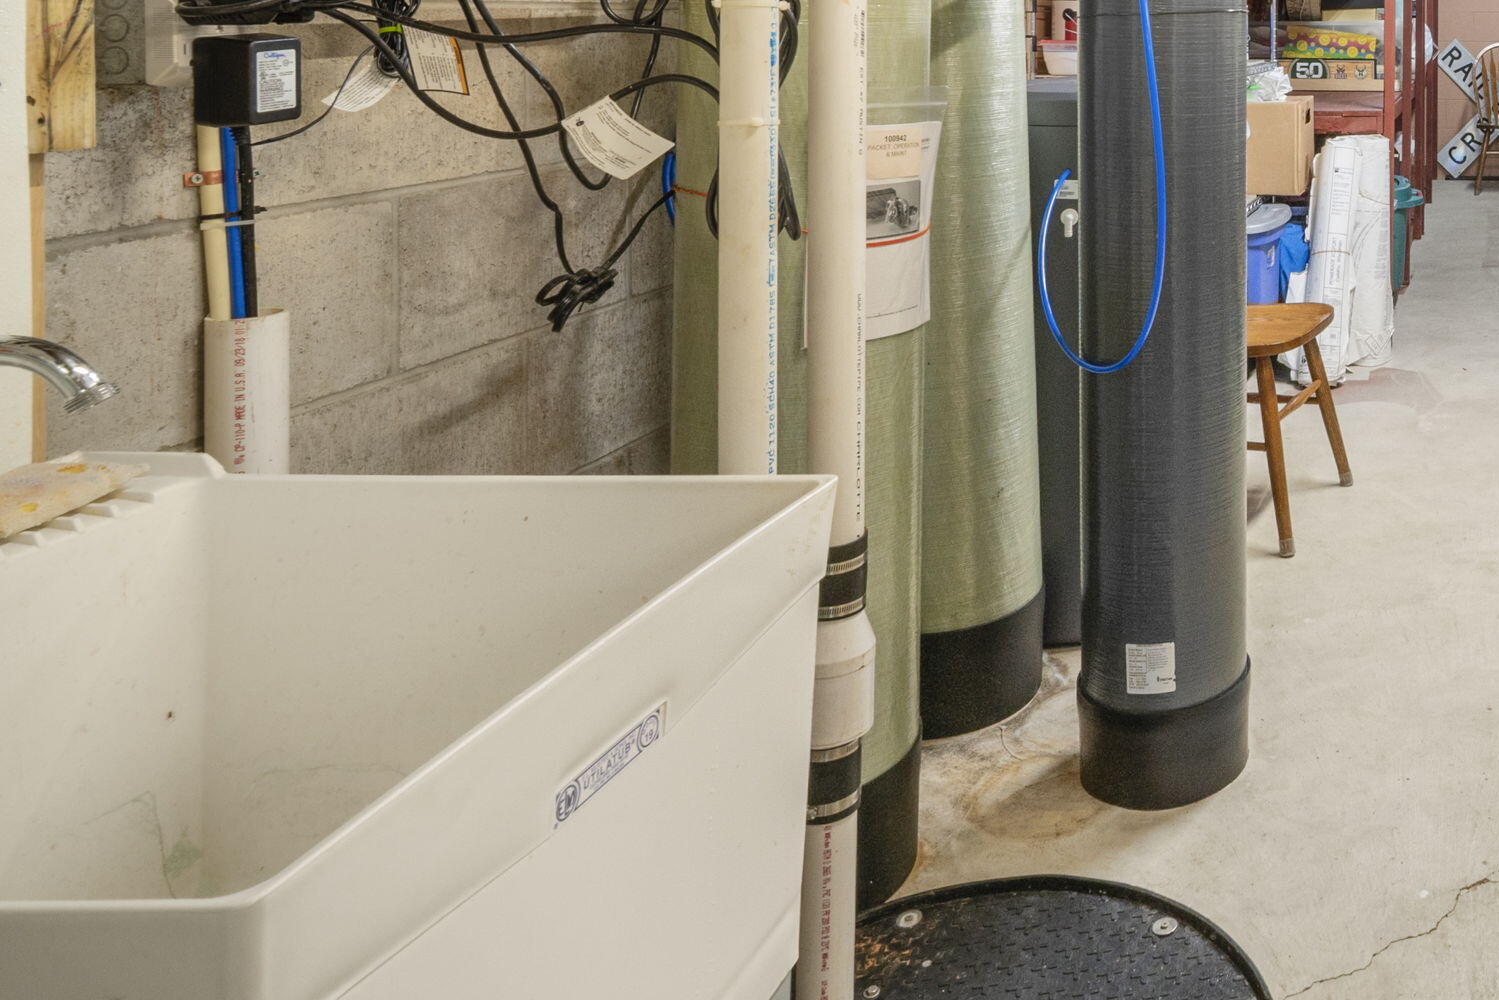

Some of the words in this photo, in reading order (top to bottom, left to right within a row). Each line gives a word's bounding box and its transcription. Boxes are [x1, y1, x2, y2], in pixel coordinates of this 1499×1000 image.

[1296, 62, 1323, 79] 50
[234, 394, 246, 403] IN
[767, 371, 776, 411] SCH40
[234, 405, 246, 420] MADE
[767, 414, 776, 446] 1120
[767, 449, 776, 475] PVC
[582, 742, 632, 791] UTILATUB
